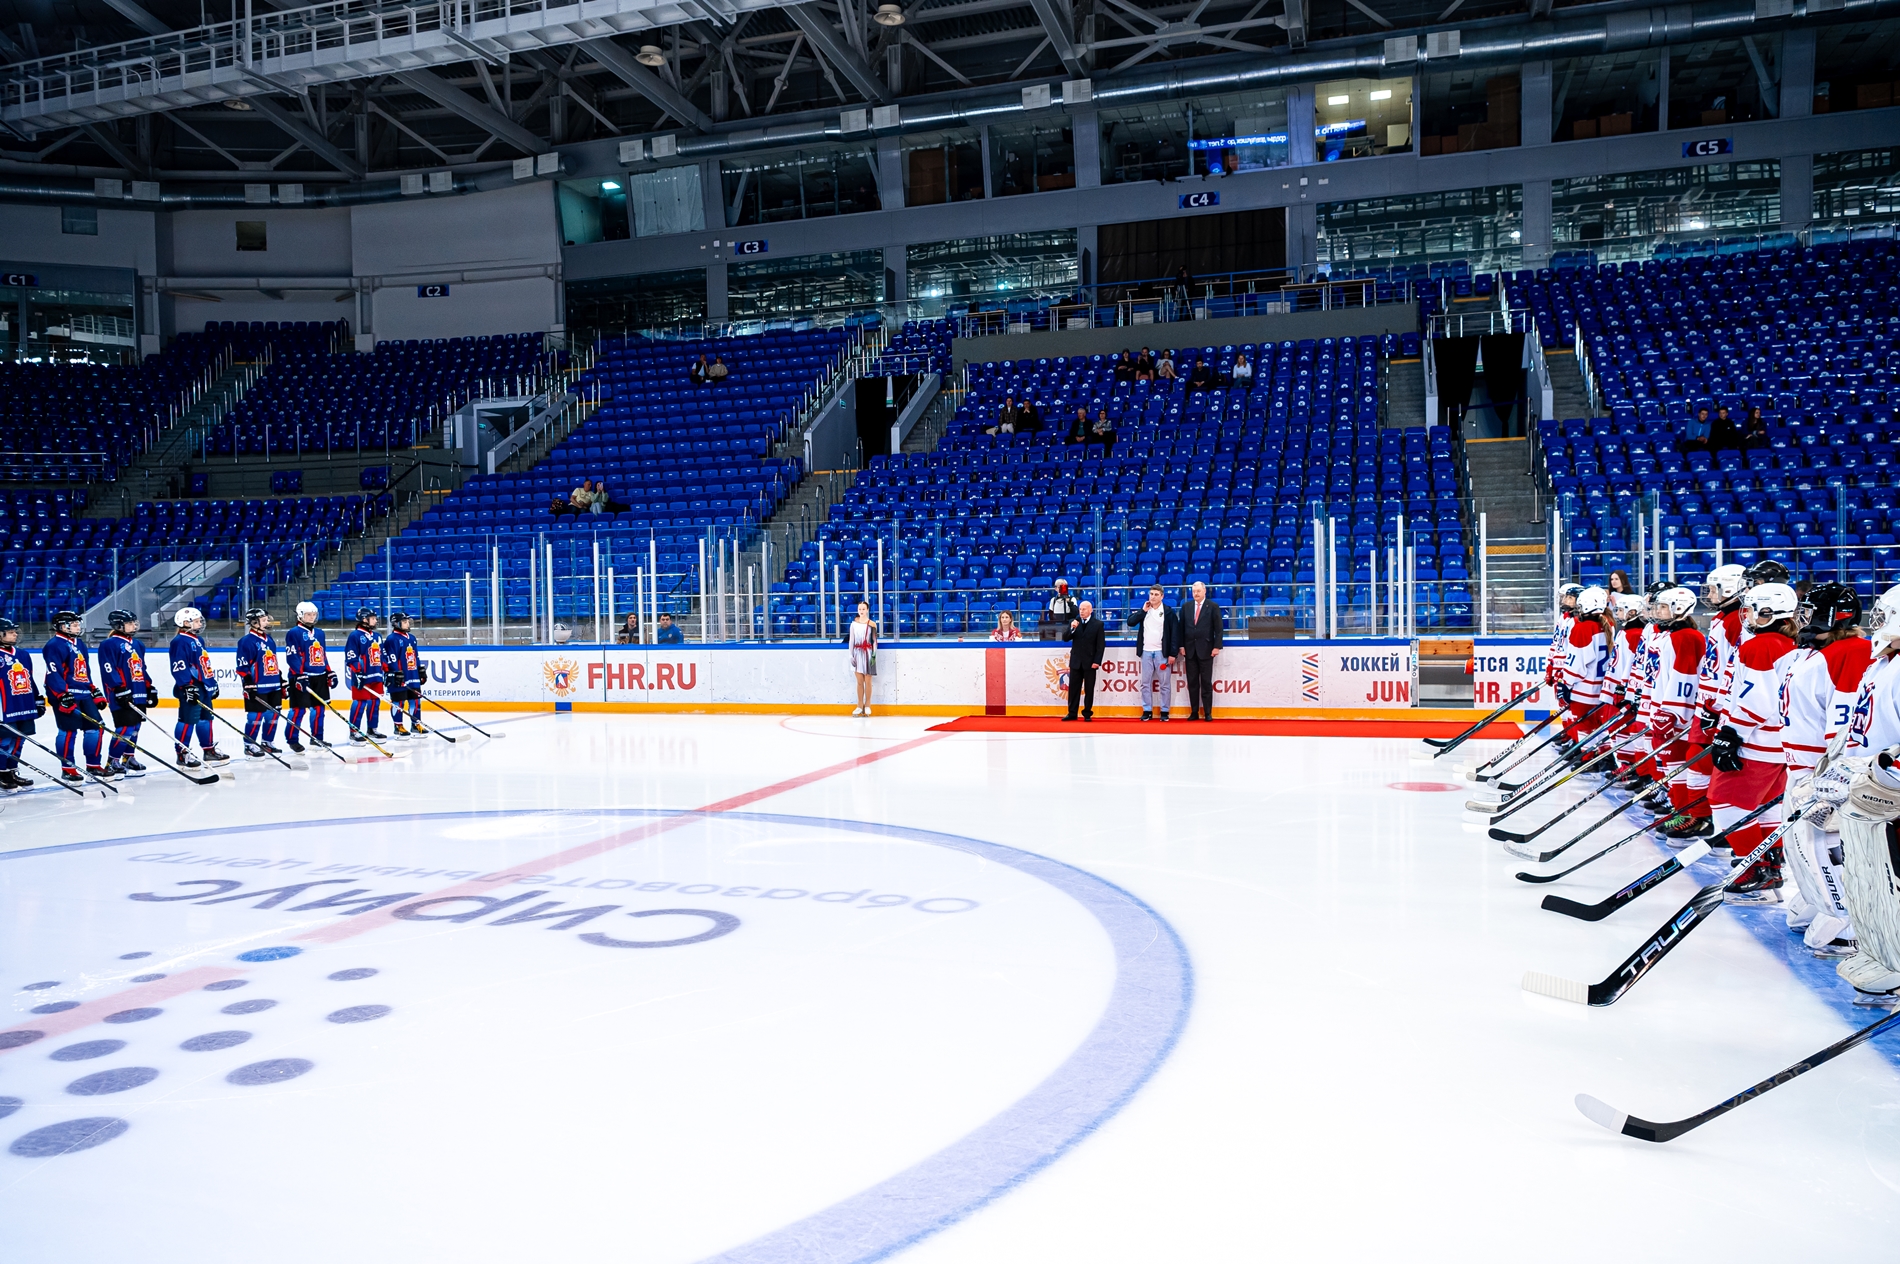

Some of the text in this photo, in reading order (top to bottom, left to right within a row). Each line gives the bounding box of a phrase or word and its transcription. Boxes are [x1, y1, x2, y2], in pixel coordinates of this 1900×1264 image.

[286, 644, 297, 656] 24
[387, 653, 397, 664] 19
[104, 662, 112, 674] 8
[172, 660, 186, 672] 23
[1340, 652, 1400, 672] ХОККЕЙ
[1516, 656, 1546, 674] ЗДЕ
[1596, 645, 1610, 677] 2
[587, 662, 696, 690] FHR.RU
[1677, 682, 1694, 698] 10
[1738, 680, 1755, 699] 7
[127, 850, 981, 914] Образовательный центр
[1615, 857, 1683, 901] TRU
[1821, 866, 1845, 911] BAUER
[128, 879, 742, 948] Сириус
[1620, 906, 1698, 978] TRUE
